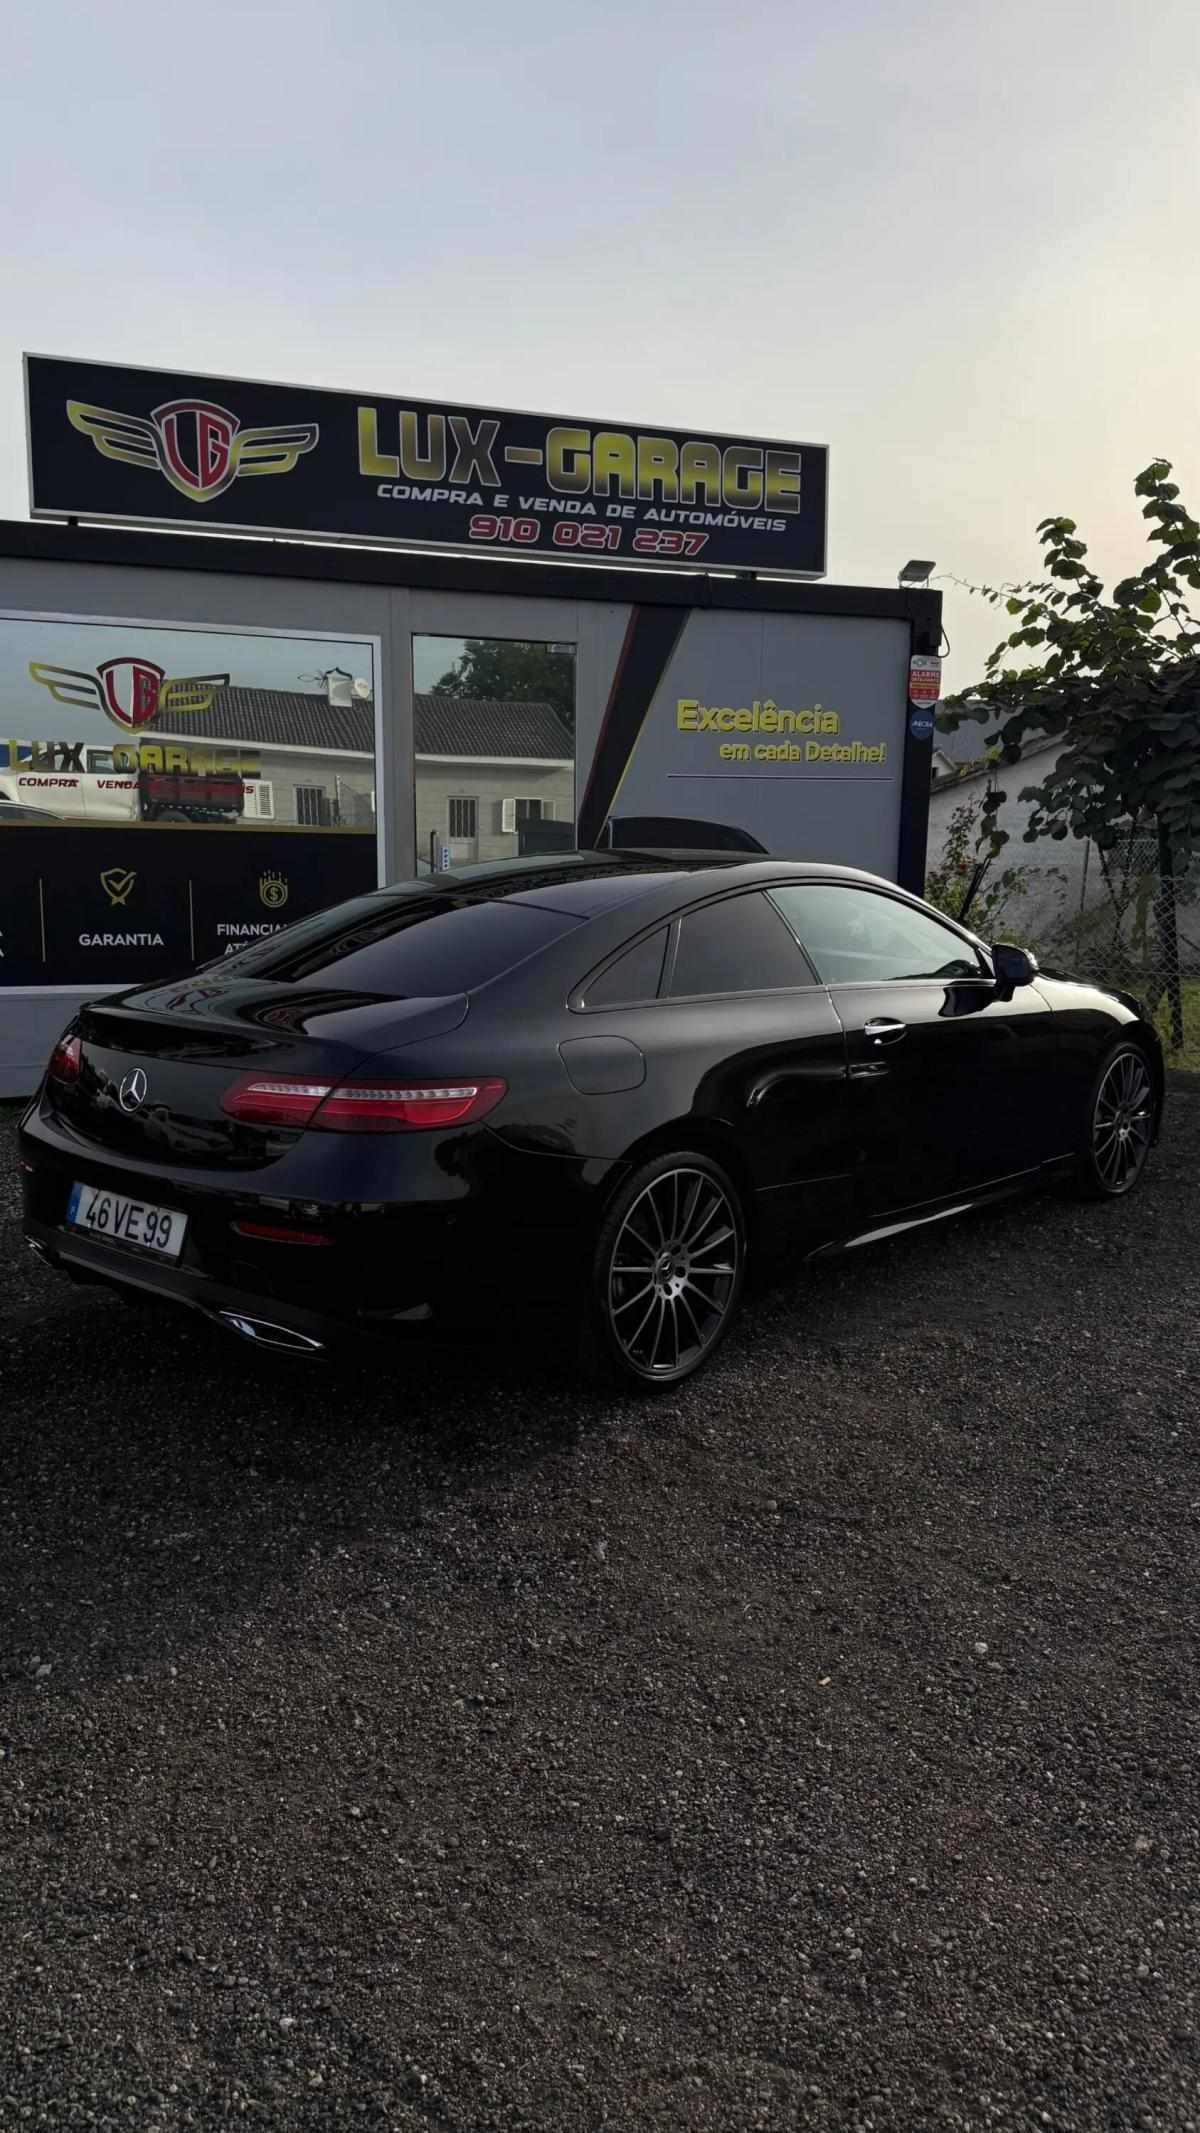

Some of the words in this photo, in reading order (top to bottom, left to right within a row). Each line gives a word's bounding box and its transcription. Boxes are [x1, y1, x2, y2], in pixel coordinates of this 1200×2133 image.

[357, 406, 801, 514] LUX-GARAGE
[376, 484, 483, 506] COMPRA
[493, 494, 509, 508] E
[519, 496, 597, 516] VENDA
[606, 503, 637, 520] DE
[643, 510, 787, 532] AUTOMÓVEIS
[468, 514, 541, 543] 910
[552, 521, 622, 551] 021
[632, 527, 710, 557] 237
[676, 699, 840, 736] Excelência
[719, 743, 751, 760] em
[754, 740, 801, 762] cada
[805, 740, 887, 764] Detalhe!
[18, 777, 81, 788] COMPRA
[78, 933, 165, 947] GARANTIA
[85, 1189, 173, 1249] 46VE99
